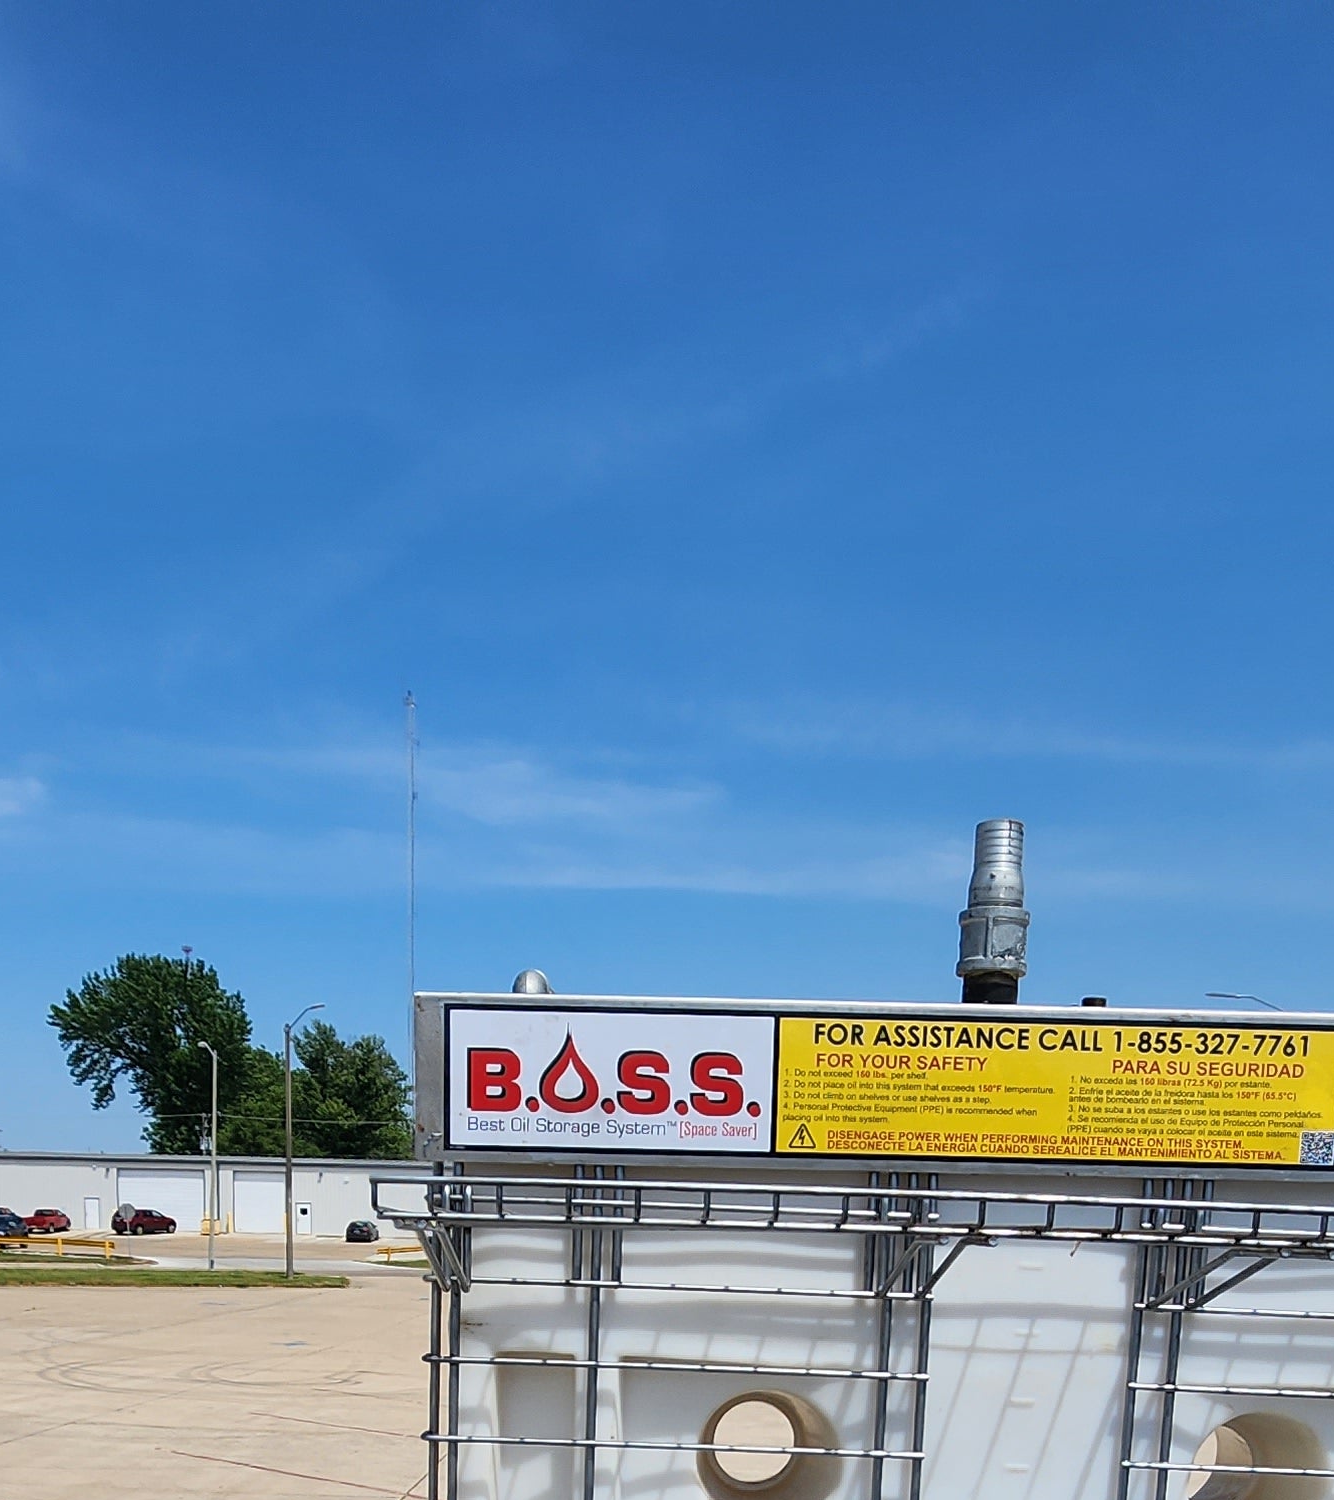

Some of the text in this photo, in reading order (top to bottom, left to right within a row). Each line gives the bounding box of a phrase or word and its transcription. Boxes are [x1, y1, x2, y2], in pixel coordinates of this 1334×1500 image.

[814, 1022, 1308, 1056] FOR ASSISTANCE CALL 1-855-327-7761
[816, 1053, 987, 1073] FOR YOUR SAFETY
[1112, 1059, 1303, 1078] PARA SU SEGURIDAD
[823, 1069, 852, 1077] exceed
[823, 1081, 844, 1090] place
[876, 1081, 890, 1090] this
[892, 1082, 921, 1092] system
[1080, 1075, 1091, 1084] No
[1157, 1078, 1180, 1086] libras
[1183, 1078, 1204, 1088] (72.5
[1207, 1079, 1222, 1088] Kg)
[919, 1094, 950, 1102] shelves
[1154, 1088, 1161, 1096] la
[793, 1102, 828, 1110] Personal
[831, 1103, 871, 1111] Protective
[874, 1104, 917, 1114] Equipment
[919, 1104, 943, 1115] (PPE)
[955, 1106, 1013, 1114] recommended
[1015, 1108, 1036, 1116] when
[782, 1113, 811, 1123] placing
[1090, 1116, 1138, 1124] recomienda
[1179, 1117, 1208, 1126] Equipo
[468, 1116, 505, 1131] Best
[511, 1117, 529, 1132] Oil
[536, 1118, 599, 1137] Storage
[679, 1120, 717, 1138] [Space
[721, 1122, 756, 1140] Saver]
[1067, 1124, 1091, 1134] (PPE)
[1093, 1125, 1123, 1133] cuando
[1137, 1127, 1156, 1136] vaya
[827, 1130, 1244, 1148] DISENGAGE POWER WHEN PERFORMING MAINTENANCE ON THIS SYSTEM.
[827, 1141, 905, 1150] DESCONECTE
[908, 1142, 923, 1151] LA
[980, 1144, 1029, 1153] CUANDO
[1100, 1146, 1114, 1154] EL
[1117, 1146, 1211, 1157] MANTENIMIENTO
[1214, 1148, 1229, 1157] AL
[1232, 1149, 1285, 1158] SISTEMA.
